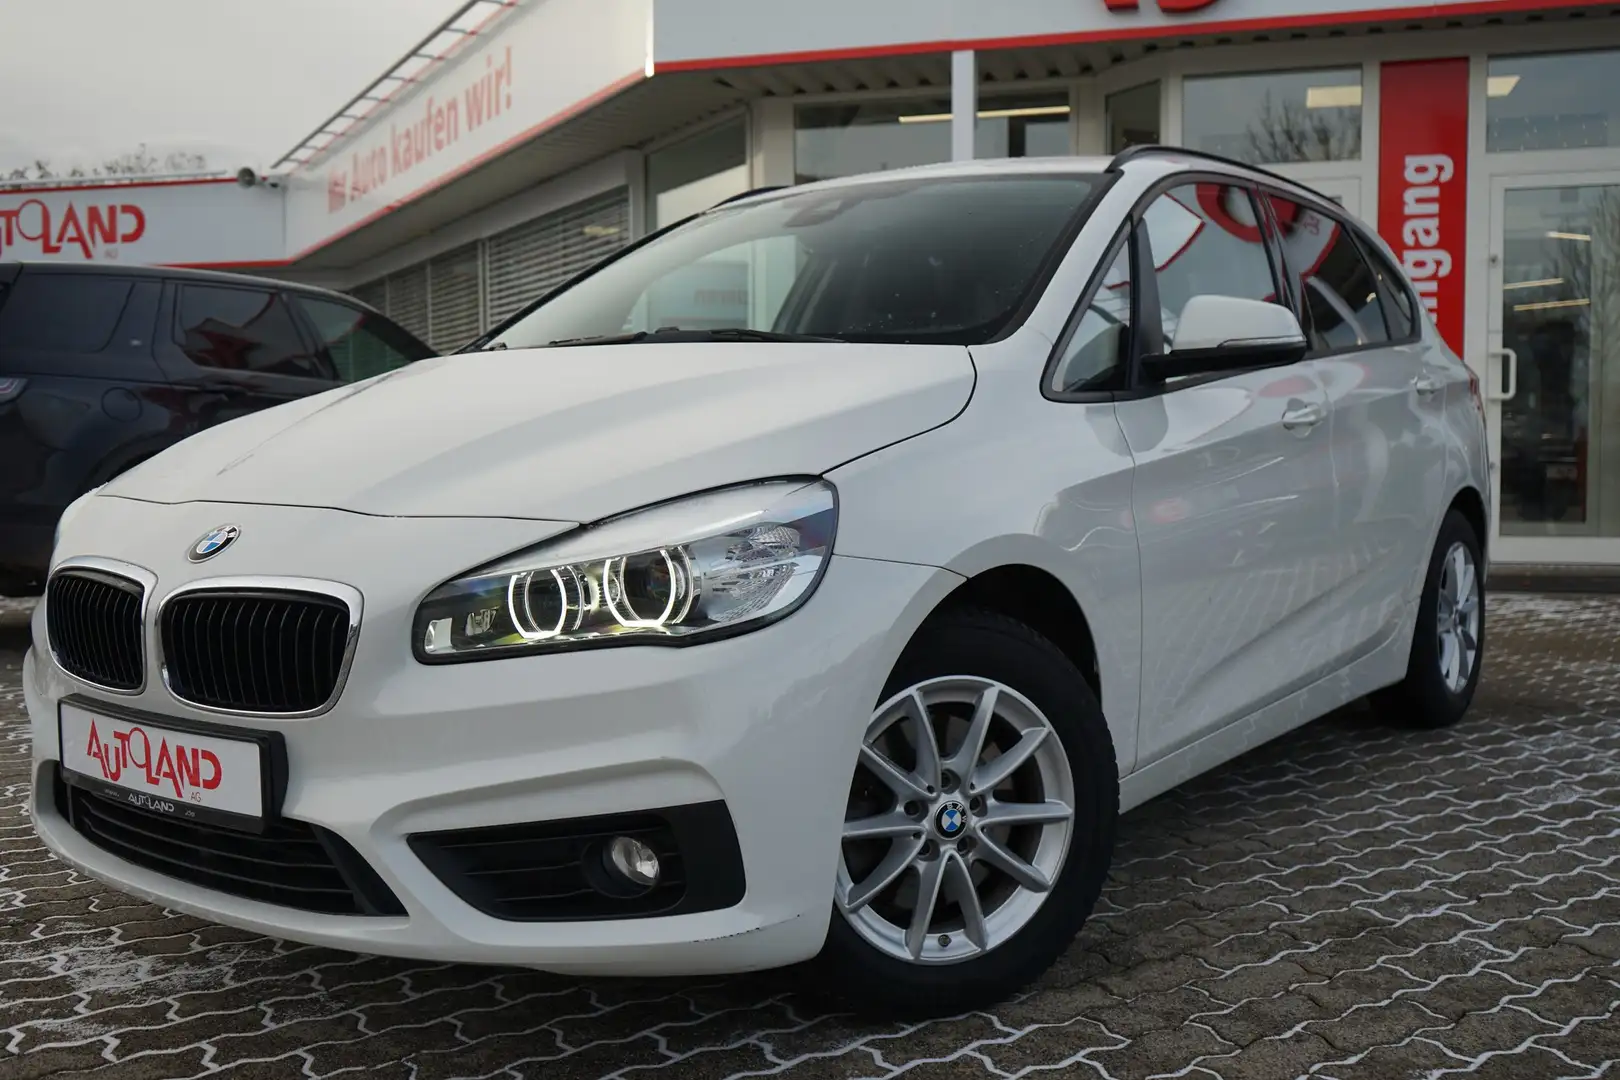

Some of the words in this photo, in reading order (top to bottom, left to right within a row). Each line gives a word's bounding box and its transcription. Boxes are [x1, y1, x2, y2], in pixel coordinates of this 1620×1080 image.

[391, 95, 458, 178] kaufen
[465, 45, 511, 132] wir!
[0, 198, 146, 260] TOLAND
[190, 791, 202, 803] AG
